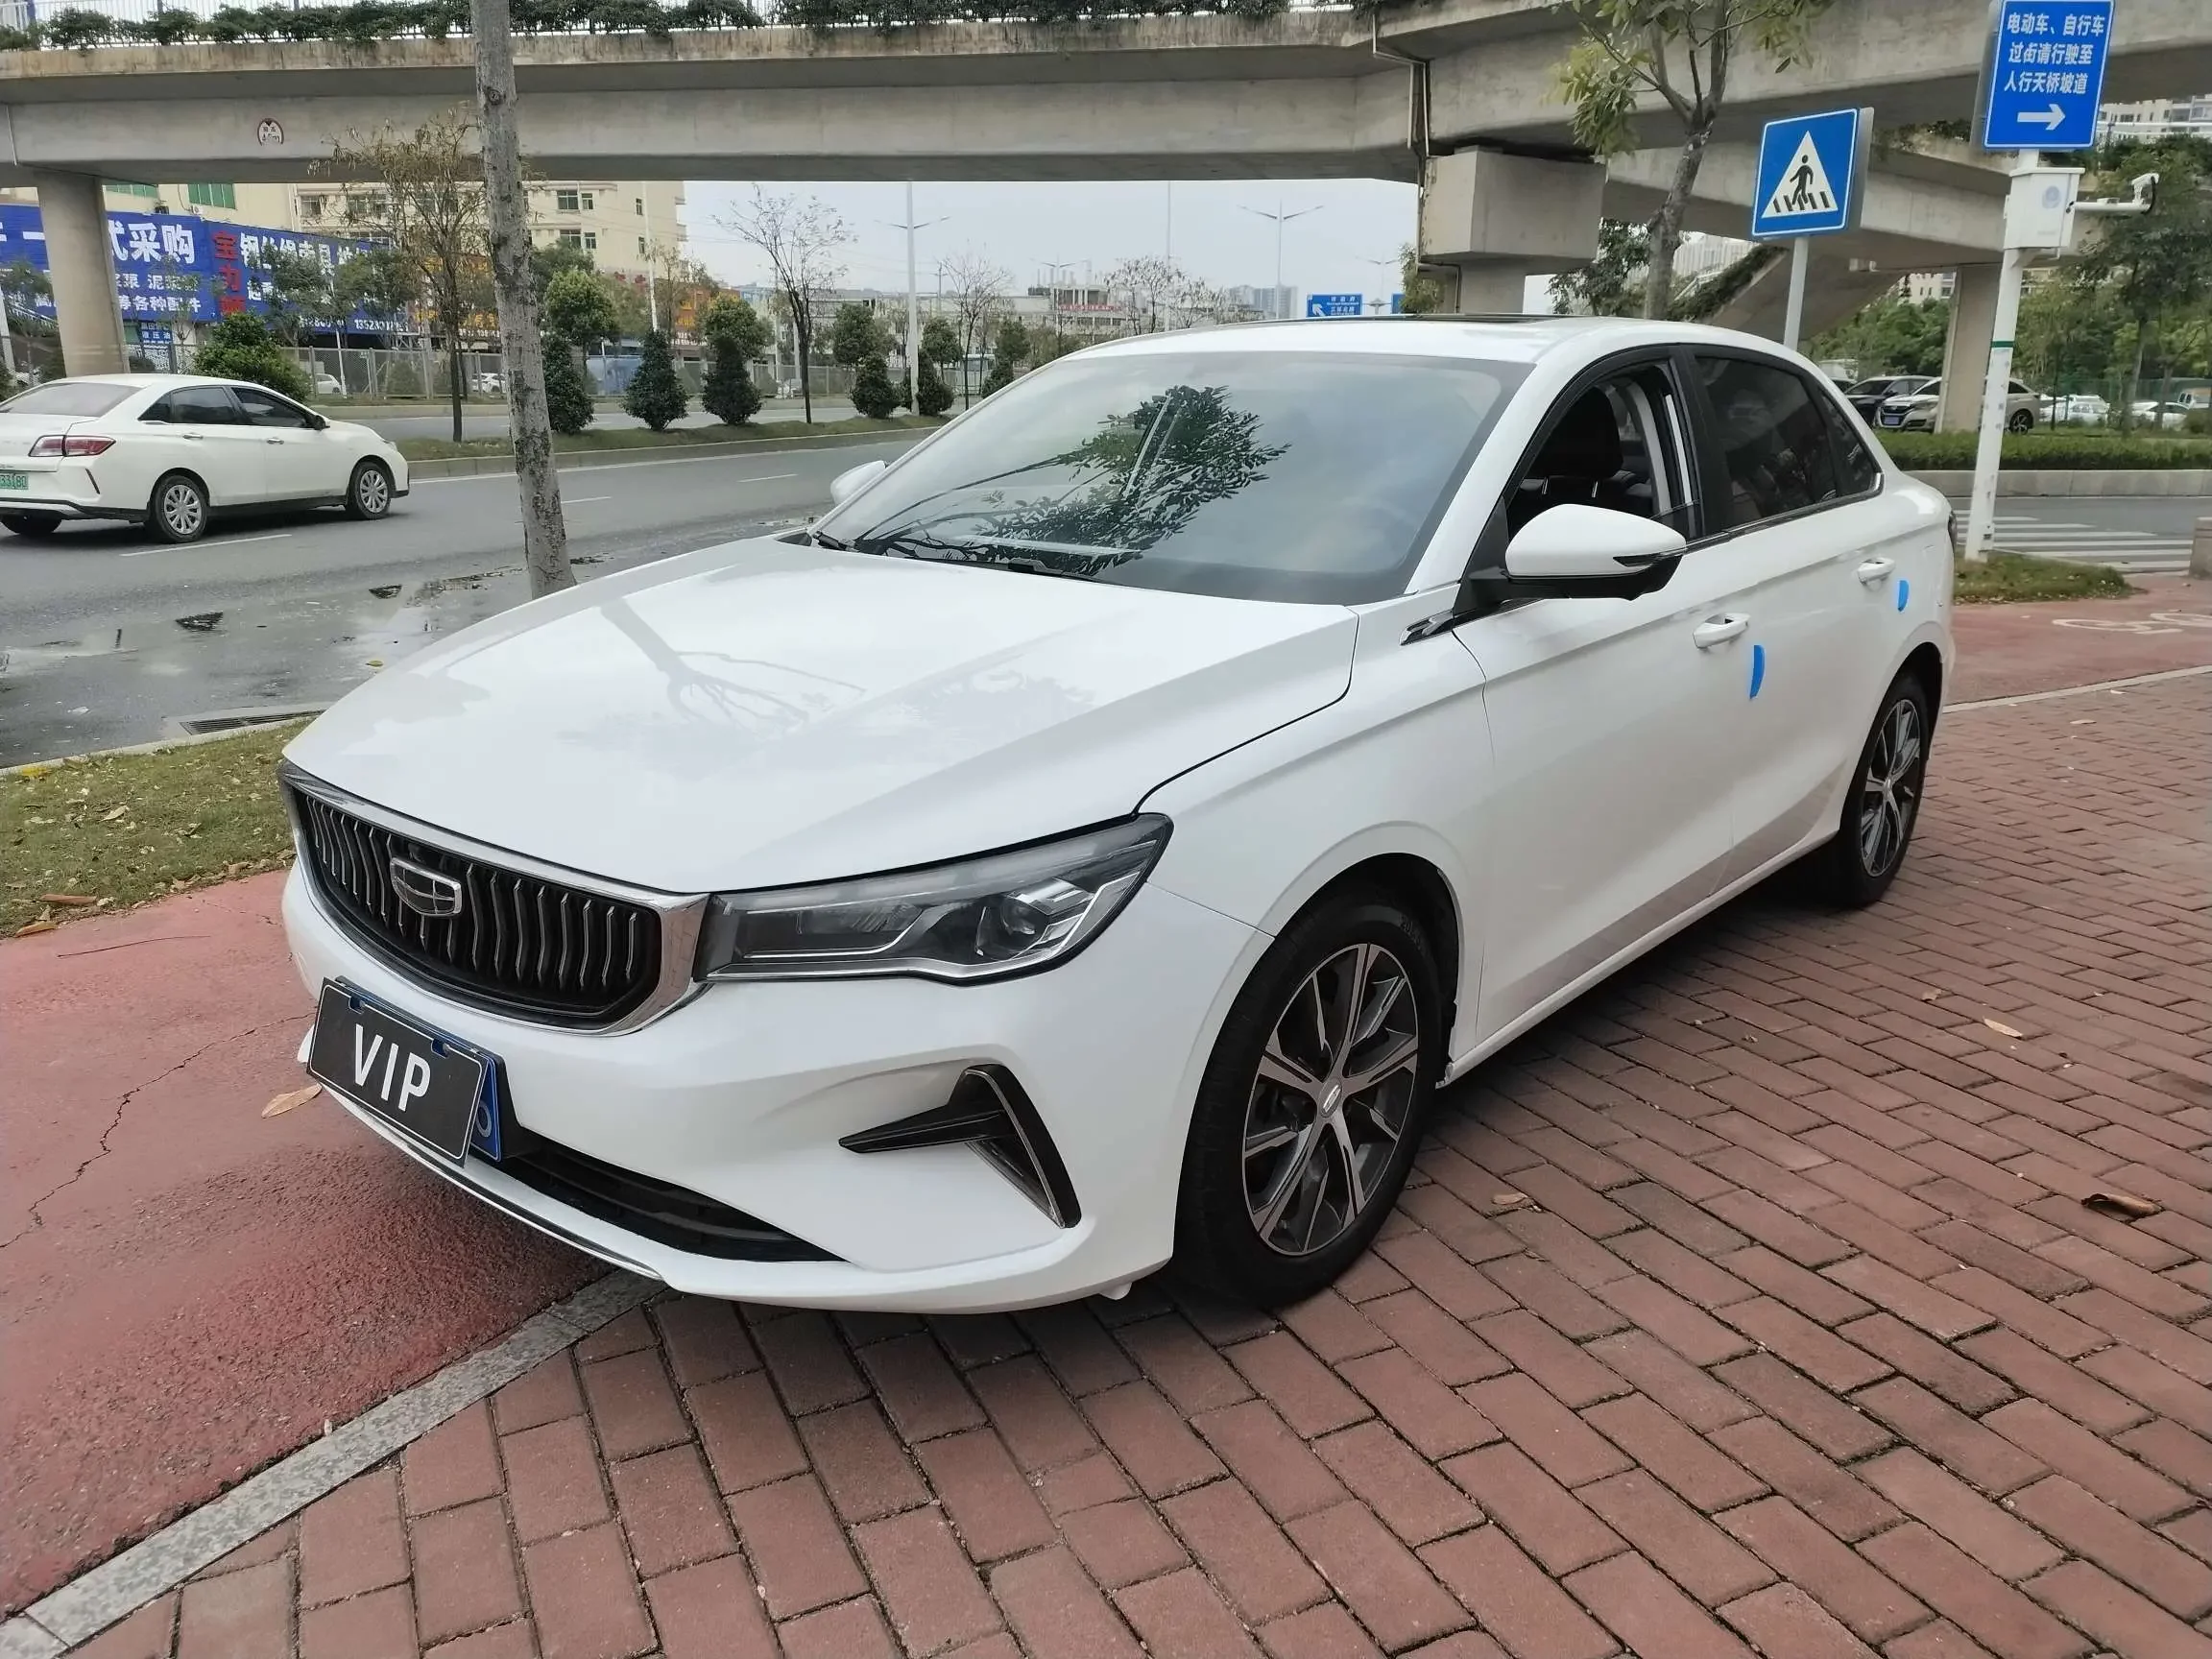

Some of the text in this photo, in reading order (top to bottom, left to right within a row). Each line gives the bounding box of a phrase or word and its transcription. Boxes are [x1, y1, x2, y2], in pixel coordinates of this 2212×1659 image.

[2007, 12, 2105, 37] 电动车、自行车
[2008, 41, 2094, 65] 过街请行驶至
[2004, 70, 2089, 95] 人行天桥坡道
[355, 1023, 431, 1112] VIP
